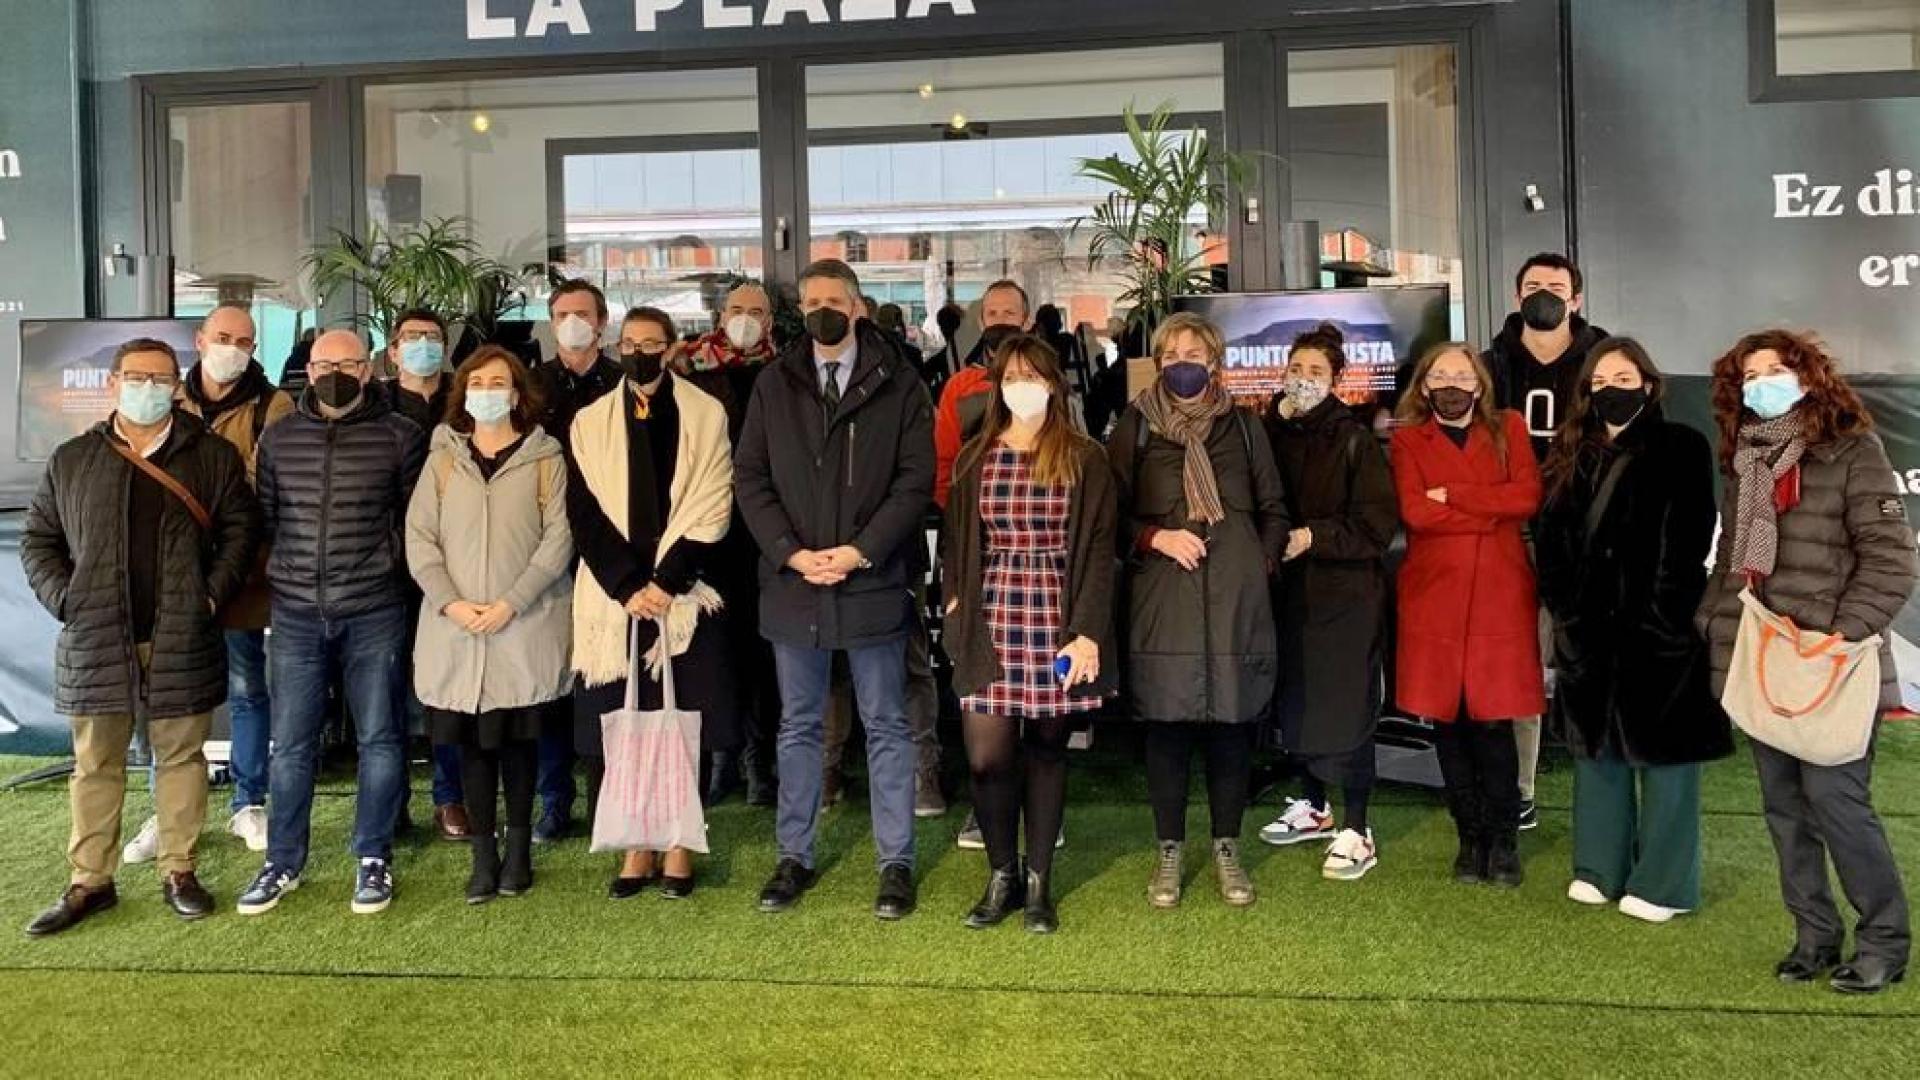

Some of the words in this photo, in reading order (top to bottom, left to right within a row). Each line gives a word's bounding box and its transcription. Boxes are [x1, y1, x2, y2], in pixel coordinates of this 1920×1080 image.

[467, 0, 591, 39] LA
[1772, 172, 1845, 218] Ez
[1857, 168, 1920, 216] di
[1859, 254, 1919, 287] er
[1226, 346, 1291, 367] PUNT
[63, 368, 109, 388] PUNT
